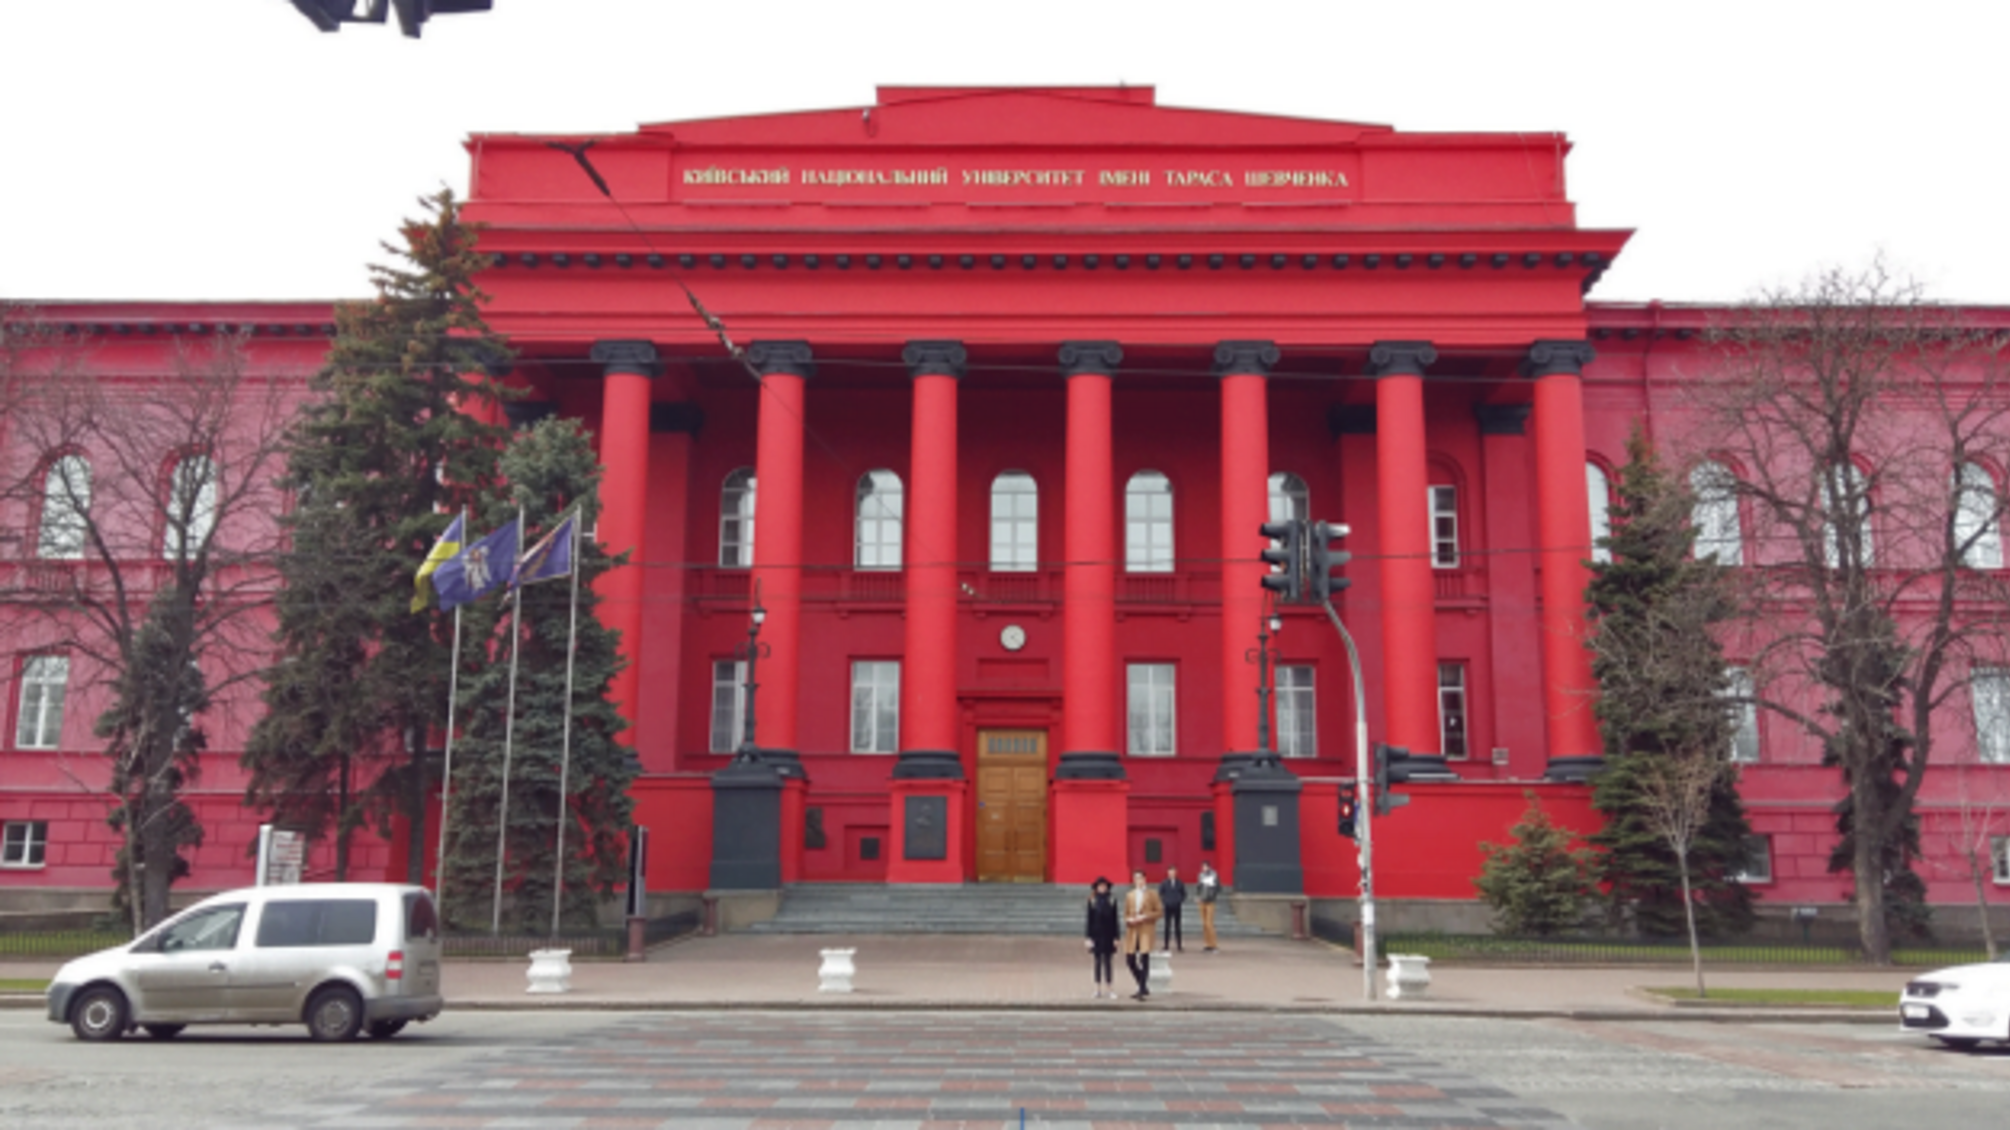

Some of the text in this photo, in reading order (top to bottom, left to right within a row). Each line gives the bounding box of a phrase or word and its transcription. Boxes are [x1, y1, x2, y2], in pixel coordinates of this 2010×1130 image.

[683, 165, 1349, 187] КИЇВСЬКИЙ НАЦІОНАЛЬНИЙ УНІВЕРСИТЕТ ІМЕНІ ТАРАСА ШЕВЧЕНКА
